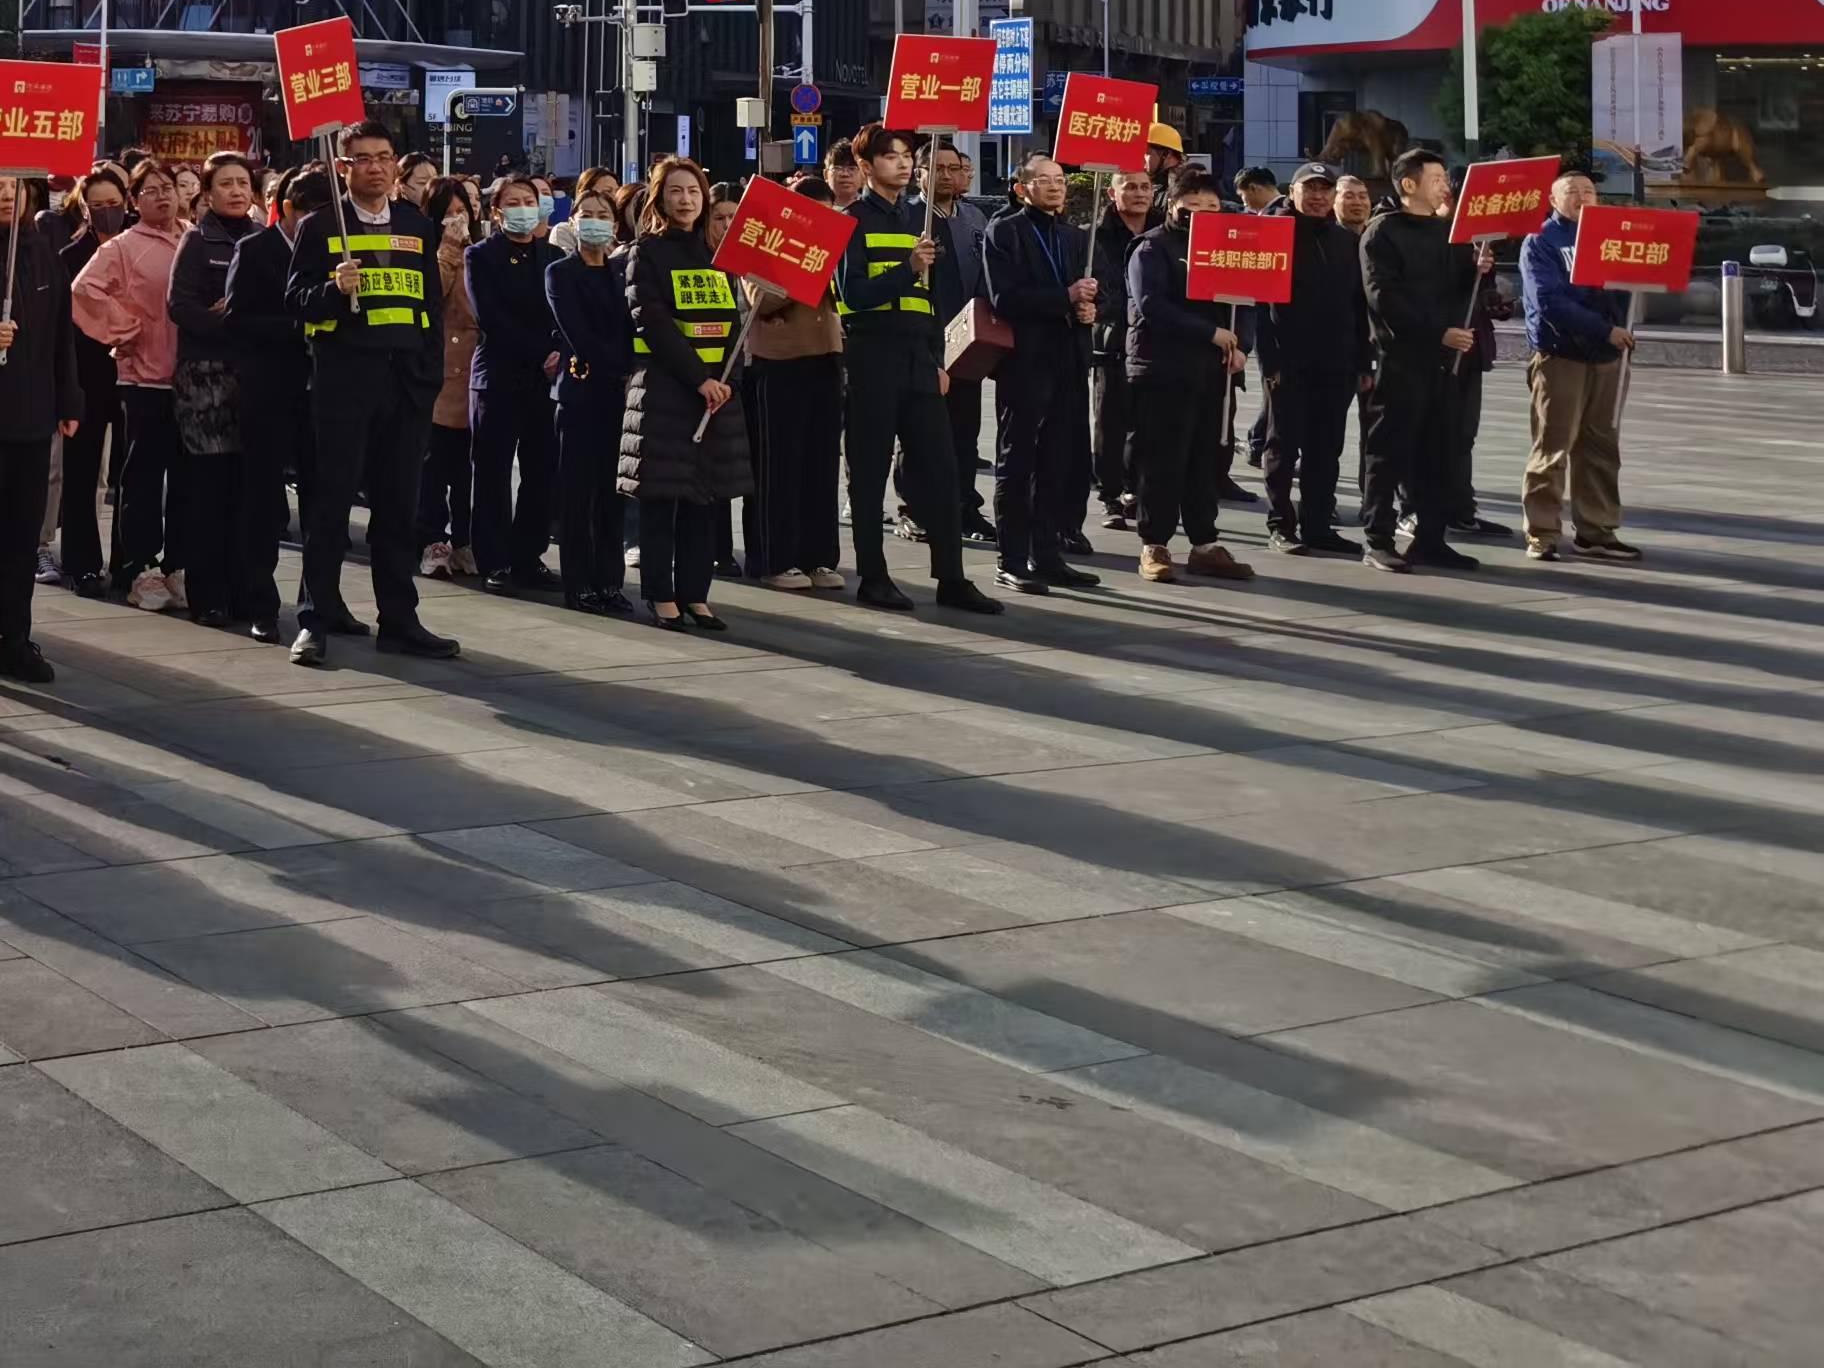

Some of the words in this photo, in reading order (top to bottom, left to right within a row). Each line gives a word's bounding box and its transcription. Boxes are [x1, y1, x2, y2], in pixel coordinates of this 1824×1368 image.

[289, 61, 352, 104] 营业三部
[900, 74, 982, 103] 营业一部
[1068, 110, 1141, 144] 医疗救护
[1467, 189, 1542, 218] 设备抢修
[738, 215, 830, 274] 营业二部
[1599, 238, 1670, 265] 保卫部
[1194, 249, 1288, 272] 二线职能部门
[357, 272, 421, 294] 防应急引导员
